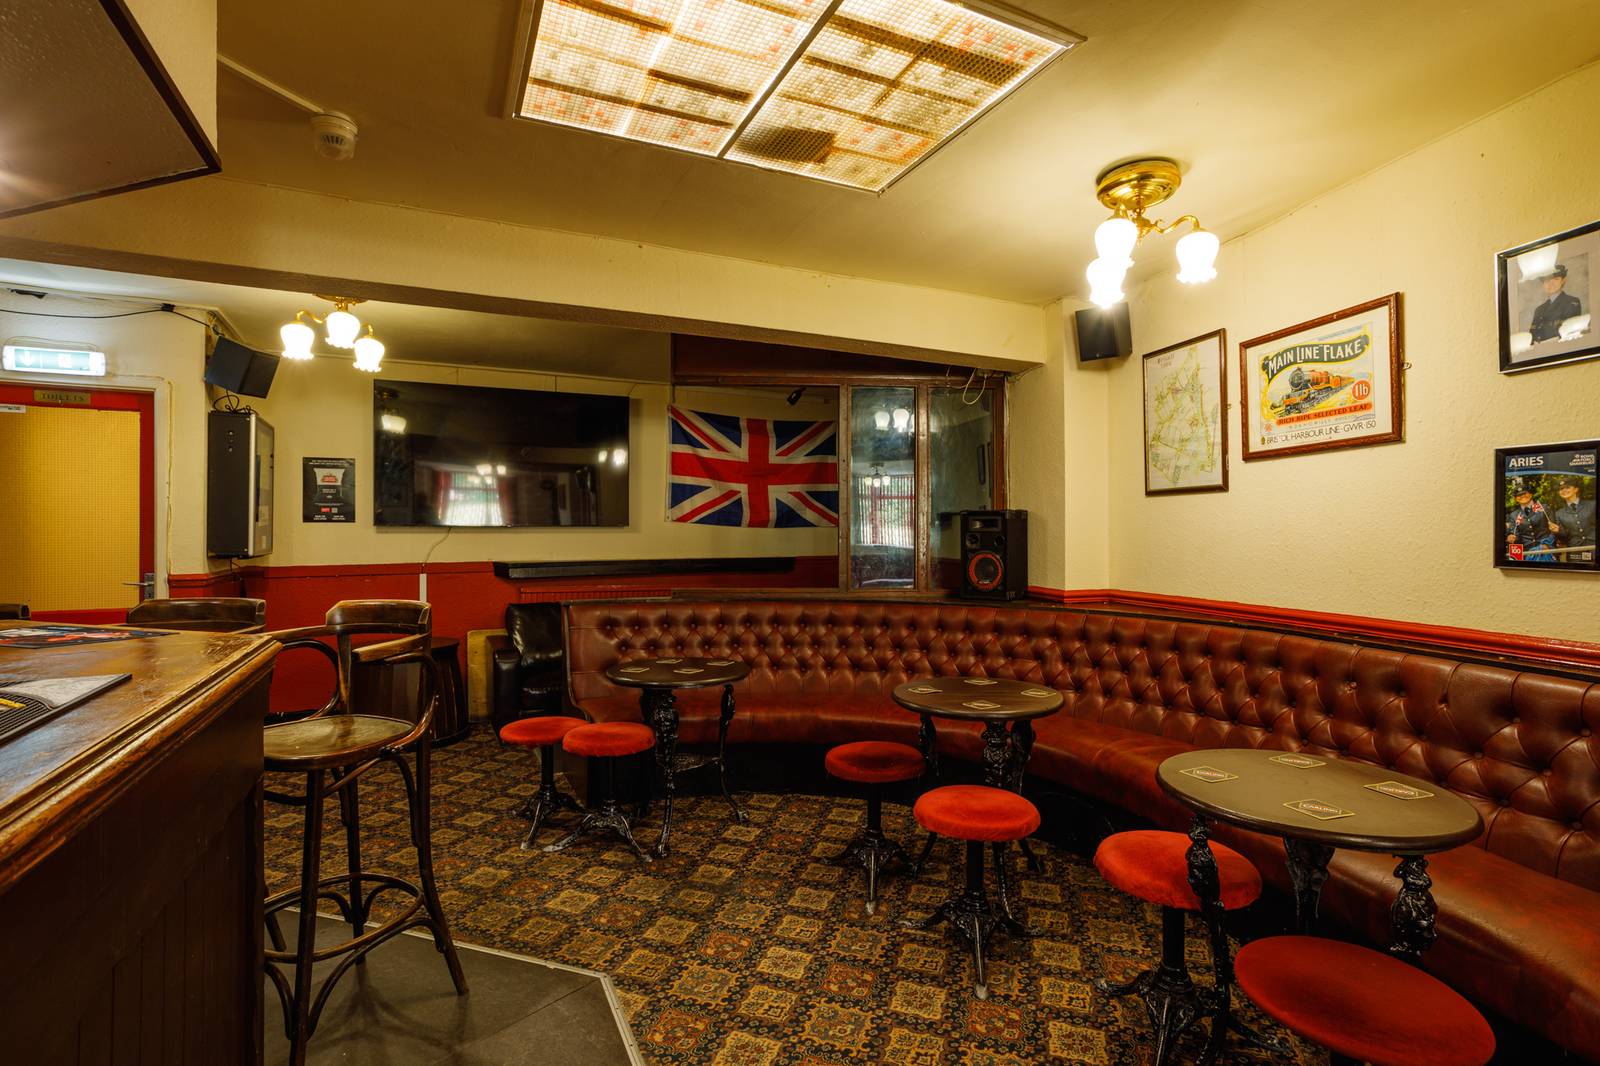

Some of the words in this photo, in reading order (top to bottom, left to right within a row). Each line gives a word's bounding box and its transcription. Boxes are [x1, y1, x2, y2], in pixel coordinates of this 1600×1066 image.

[1323, 339, 1363, 362] FLAKE
[1278, 417, 1294, 426] RICH
[1314, 408, 1348, 419] SELECTED
[1349, 403, 1369, 413] LEAF
[1291, 429, 1324, 441] HARBOUR
[1325, 425, 1341, 436] LINE
[1343, 422, 1364, 433] GWR
[1508, 455, 1544, 468] ARIES
